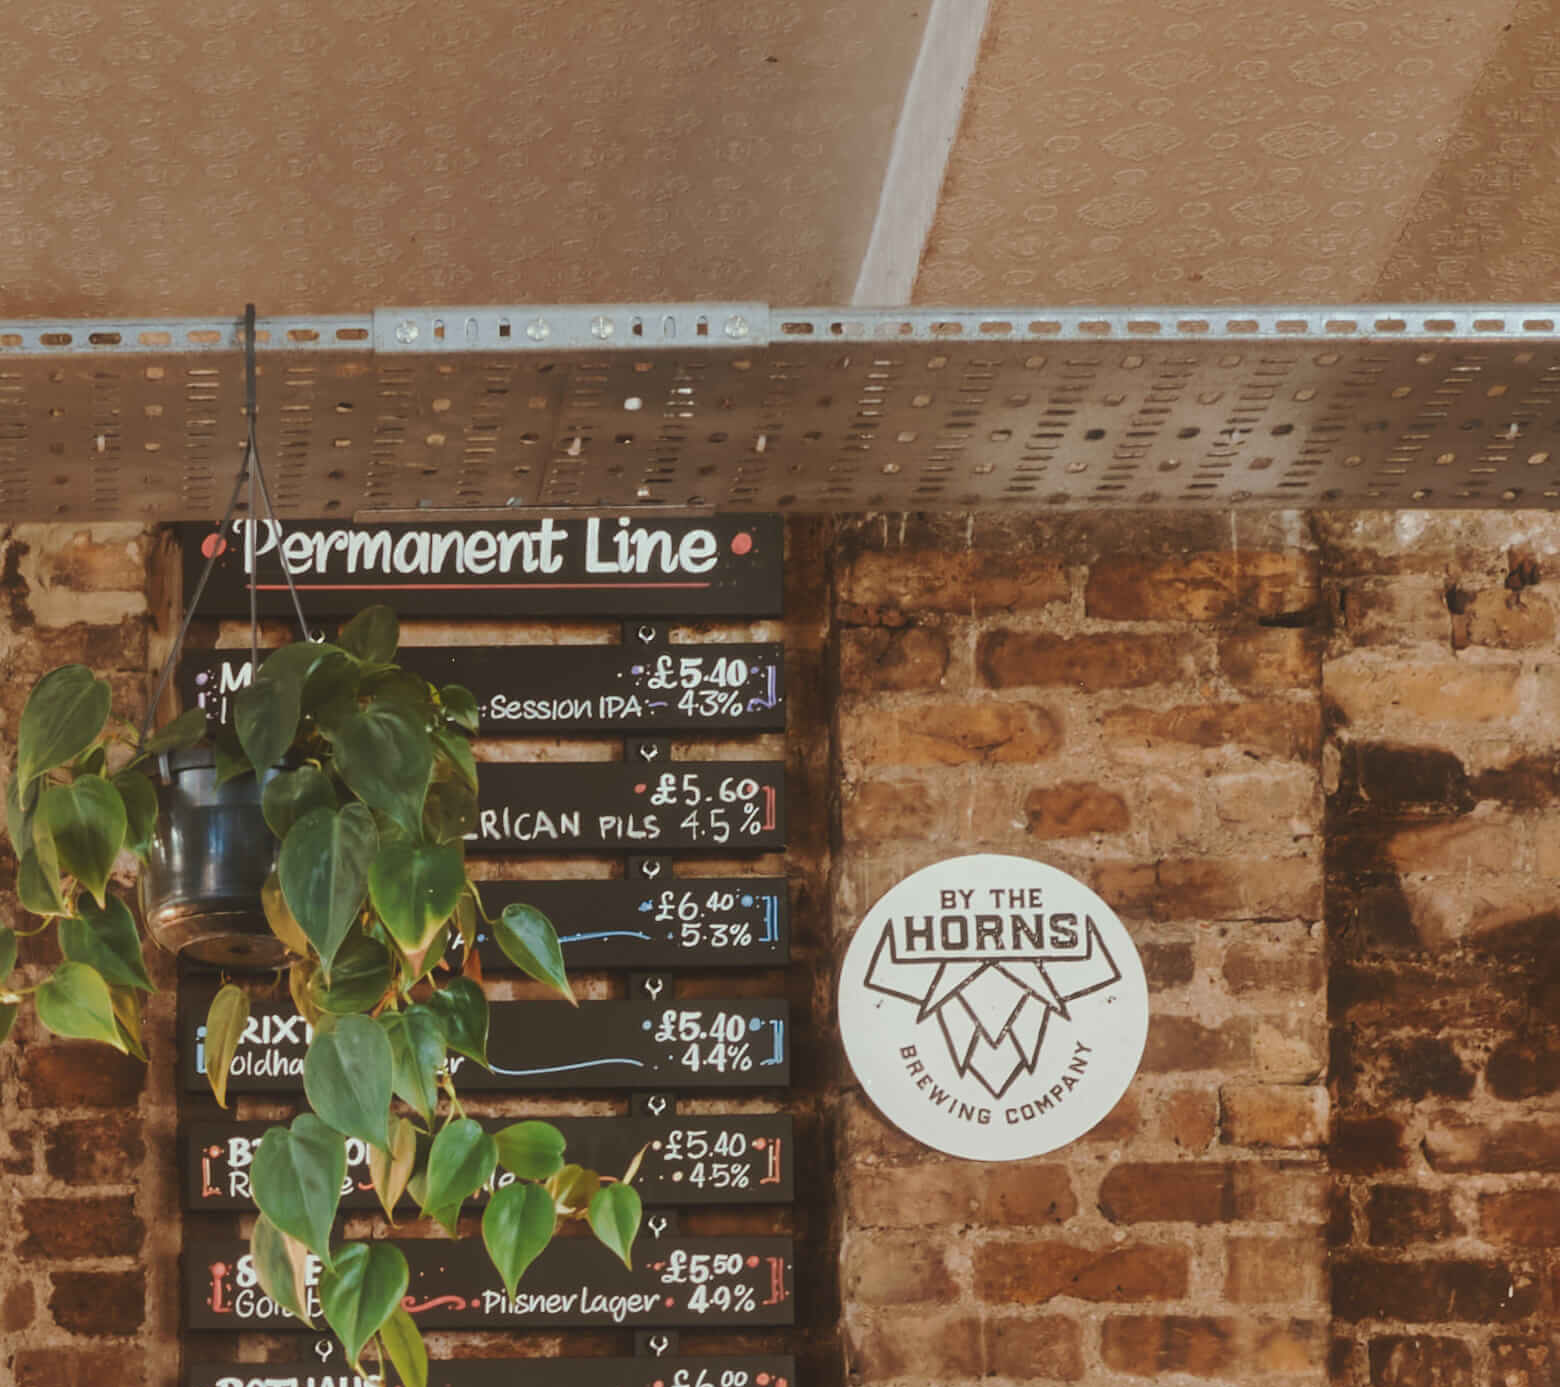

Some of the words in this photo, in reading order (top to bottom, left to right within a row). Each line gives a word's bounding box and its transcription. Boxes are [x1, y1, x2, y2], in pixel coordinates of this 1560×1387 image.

[233, 513, 569, 577] Permanent
[585, 513, 719, 575] Line
[489, 693, 594, 722] Session
[599, 693, 644, 720] IPA
[599, 812, 662, 842] PILS
[940, 888, 974, 910] BY
[989, 888, 1043, 909] THE
[903, 912, 1079, 952] HORNS
[898, 1043, 992, 1126] BREWING
[1004, 1039, 1094, 1126] COMPANY
[480, 1286, 578, 1317] Pilsner
[580, 1287, 662, 1323] Lager
